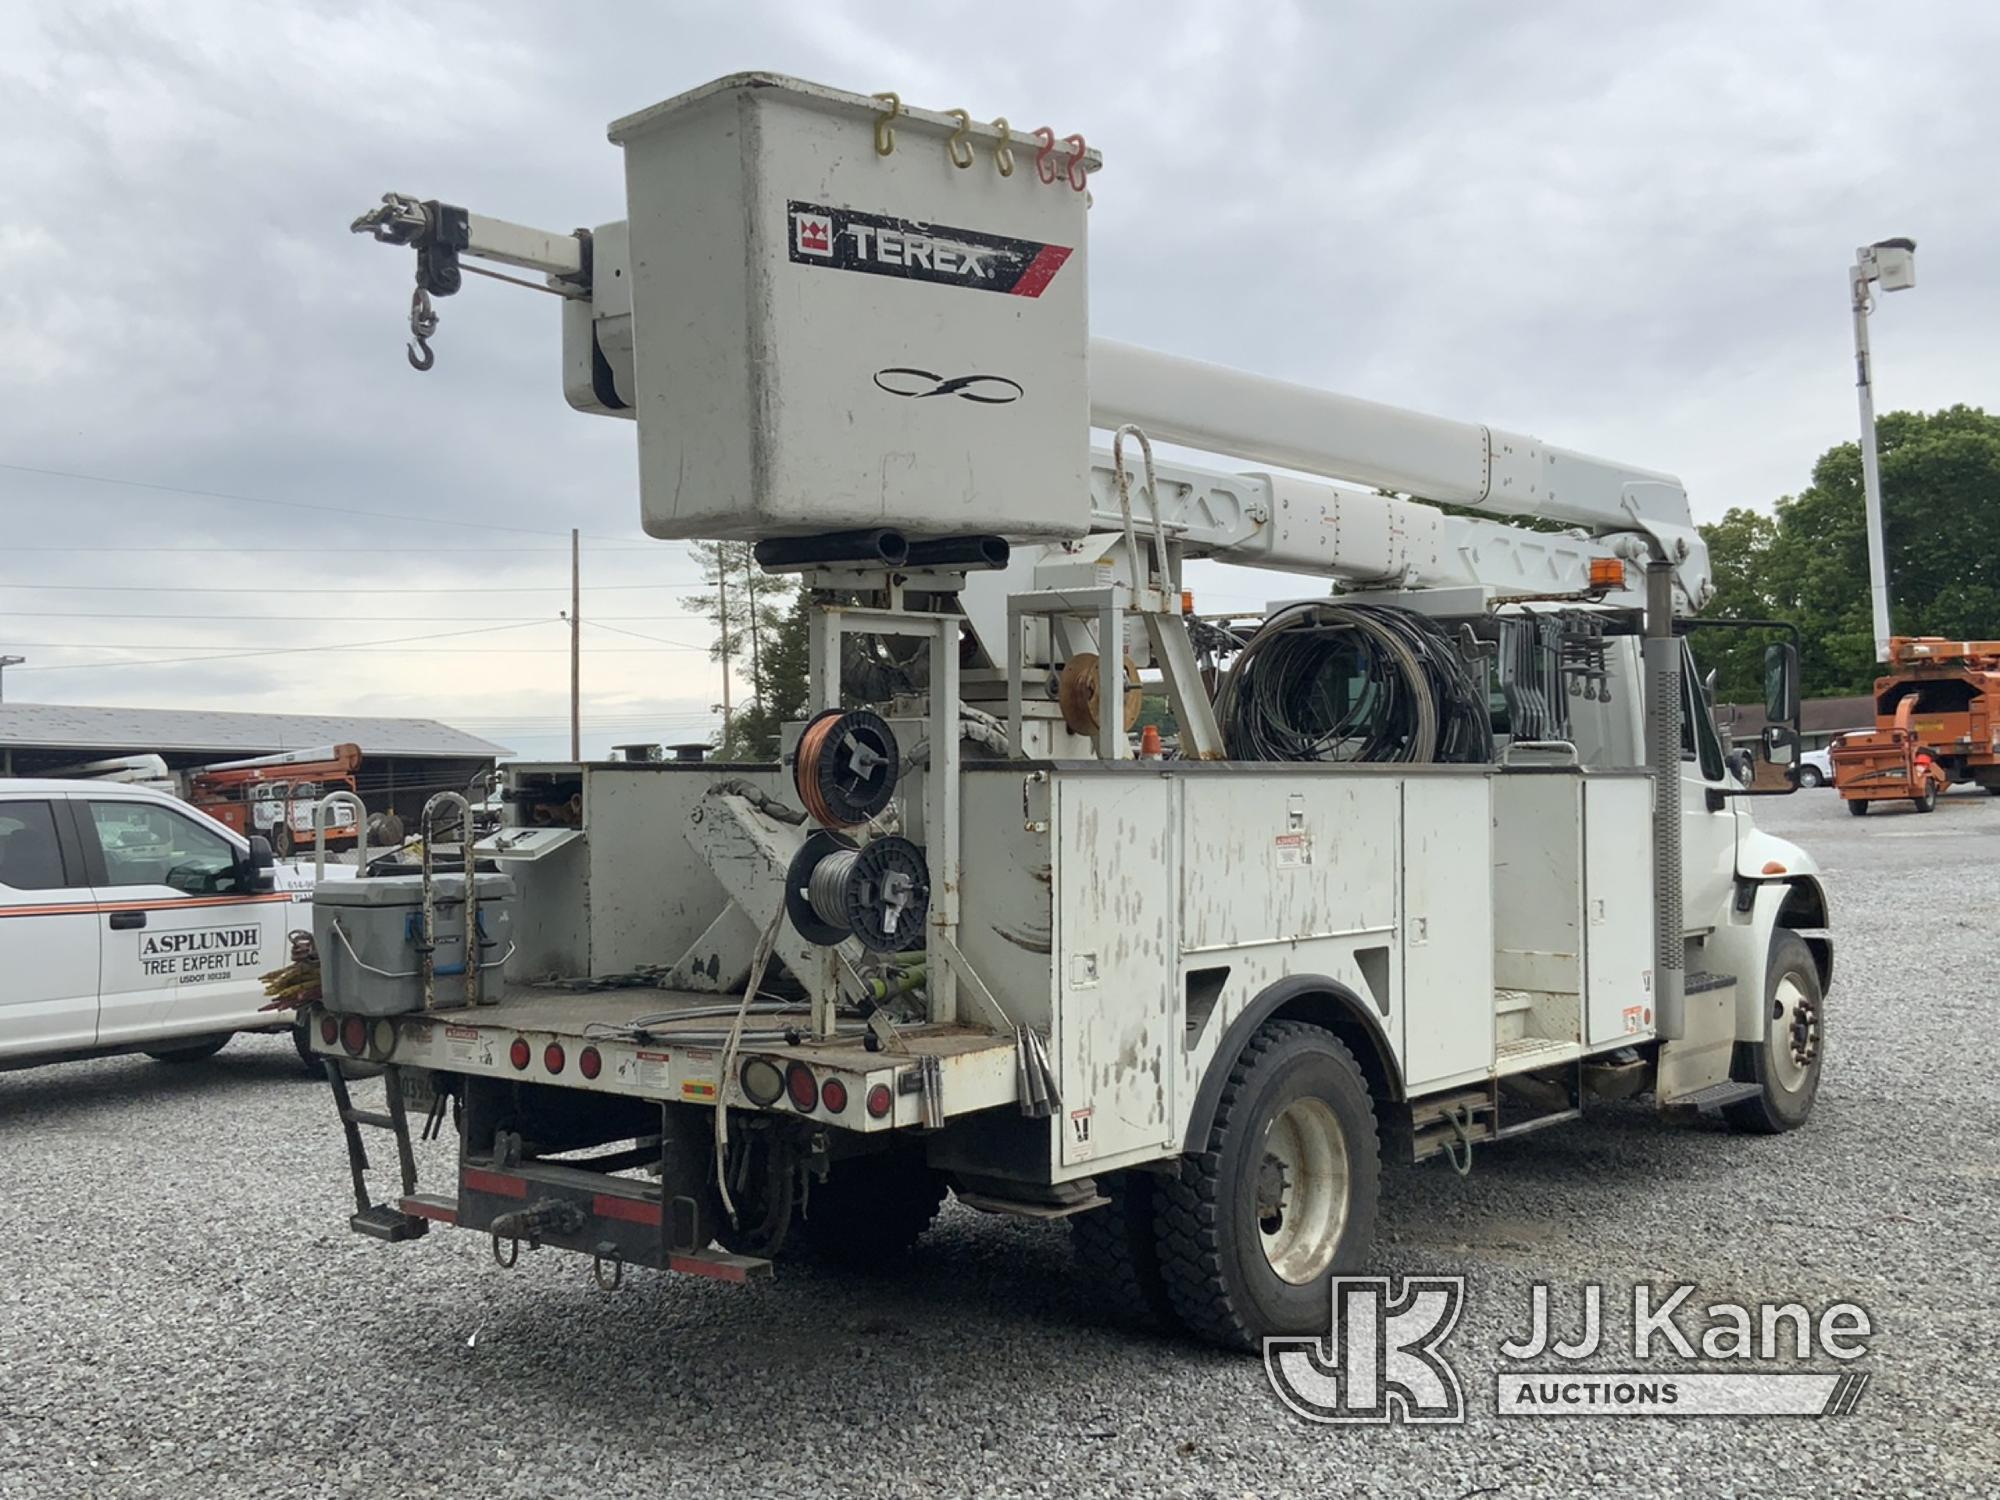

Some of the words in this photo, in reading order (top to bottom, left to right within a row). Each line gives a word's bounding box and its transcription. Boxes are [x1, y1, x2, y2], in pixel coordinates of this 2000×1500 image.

[847, 223, 986, 278] TEREX
[143, 929, 258, 954] ASPLUNDH
[142, 959, 176, 975] TREE
[182, 953, 232, 972] EXPERT
[179, 974, 205, 983] USDOT
